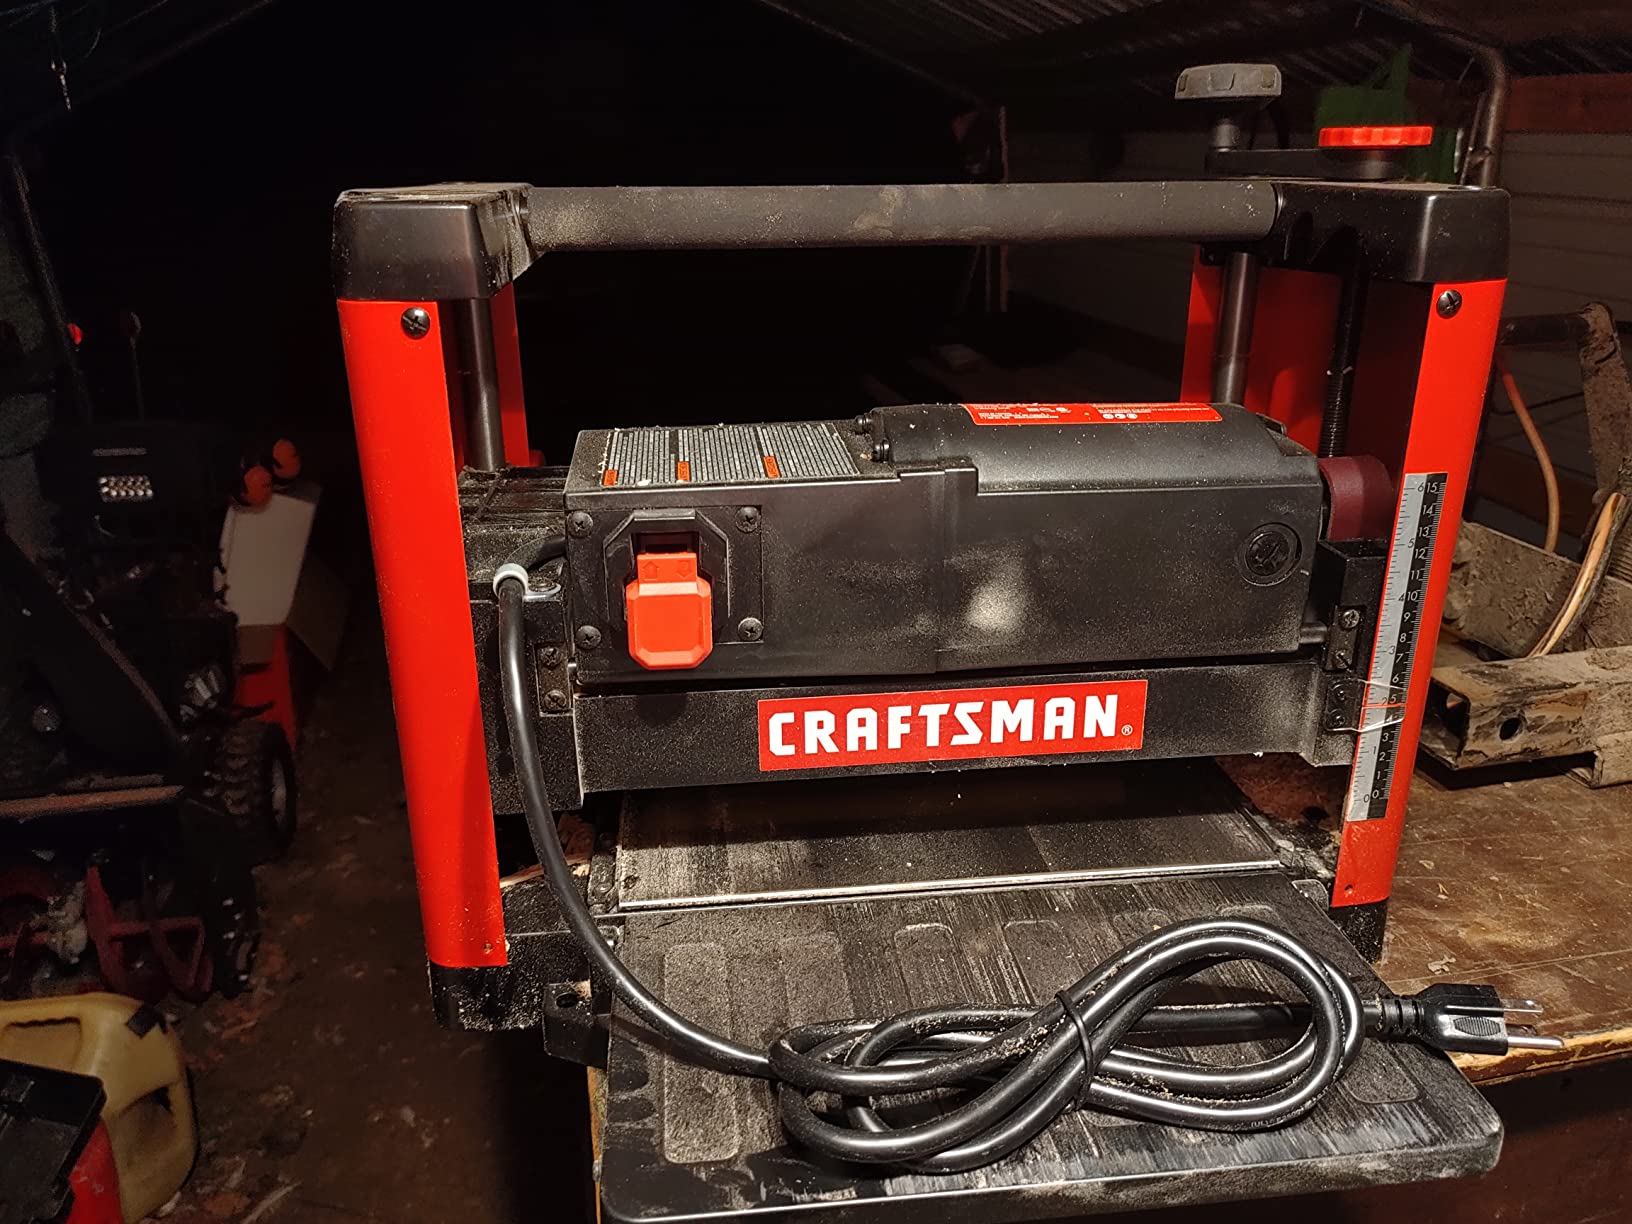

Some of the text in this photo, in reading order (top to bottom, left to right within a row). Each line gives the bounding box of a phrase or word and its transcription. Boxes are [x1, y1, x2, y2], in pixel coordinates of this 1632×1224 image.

[1418, 484, 1424, 492] 6
[1426, 483, 1437, 493] 15
[1422, 505, 1433, 515] 14
[1418, 526, 1429, 536] 13
[1408, 538, 1414, 549] 5
[1415, 549, 1425, 559] 12
[1411, 570, 1420, 580] 11
[1398, 592, 1404, 601] 4
[1407, 591, 1417, 601] 10
[1404, 613, 1410, 622] 9
[1399, 633, 1406, 643] 8
[1389, 646, 1395, 655] 3
[1396, 653, 1403, 663] 7
[1392, 675, 1399, 683] 6
[1382, 732, 1389, 742] 3
[1379, 752, 1385, 761] 2
[1363, 794, 1369, 803] 0
[1372, 789, 1379, 798] 0
